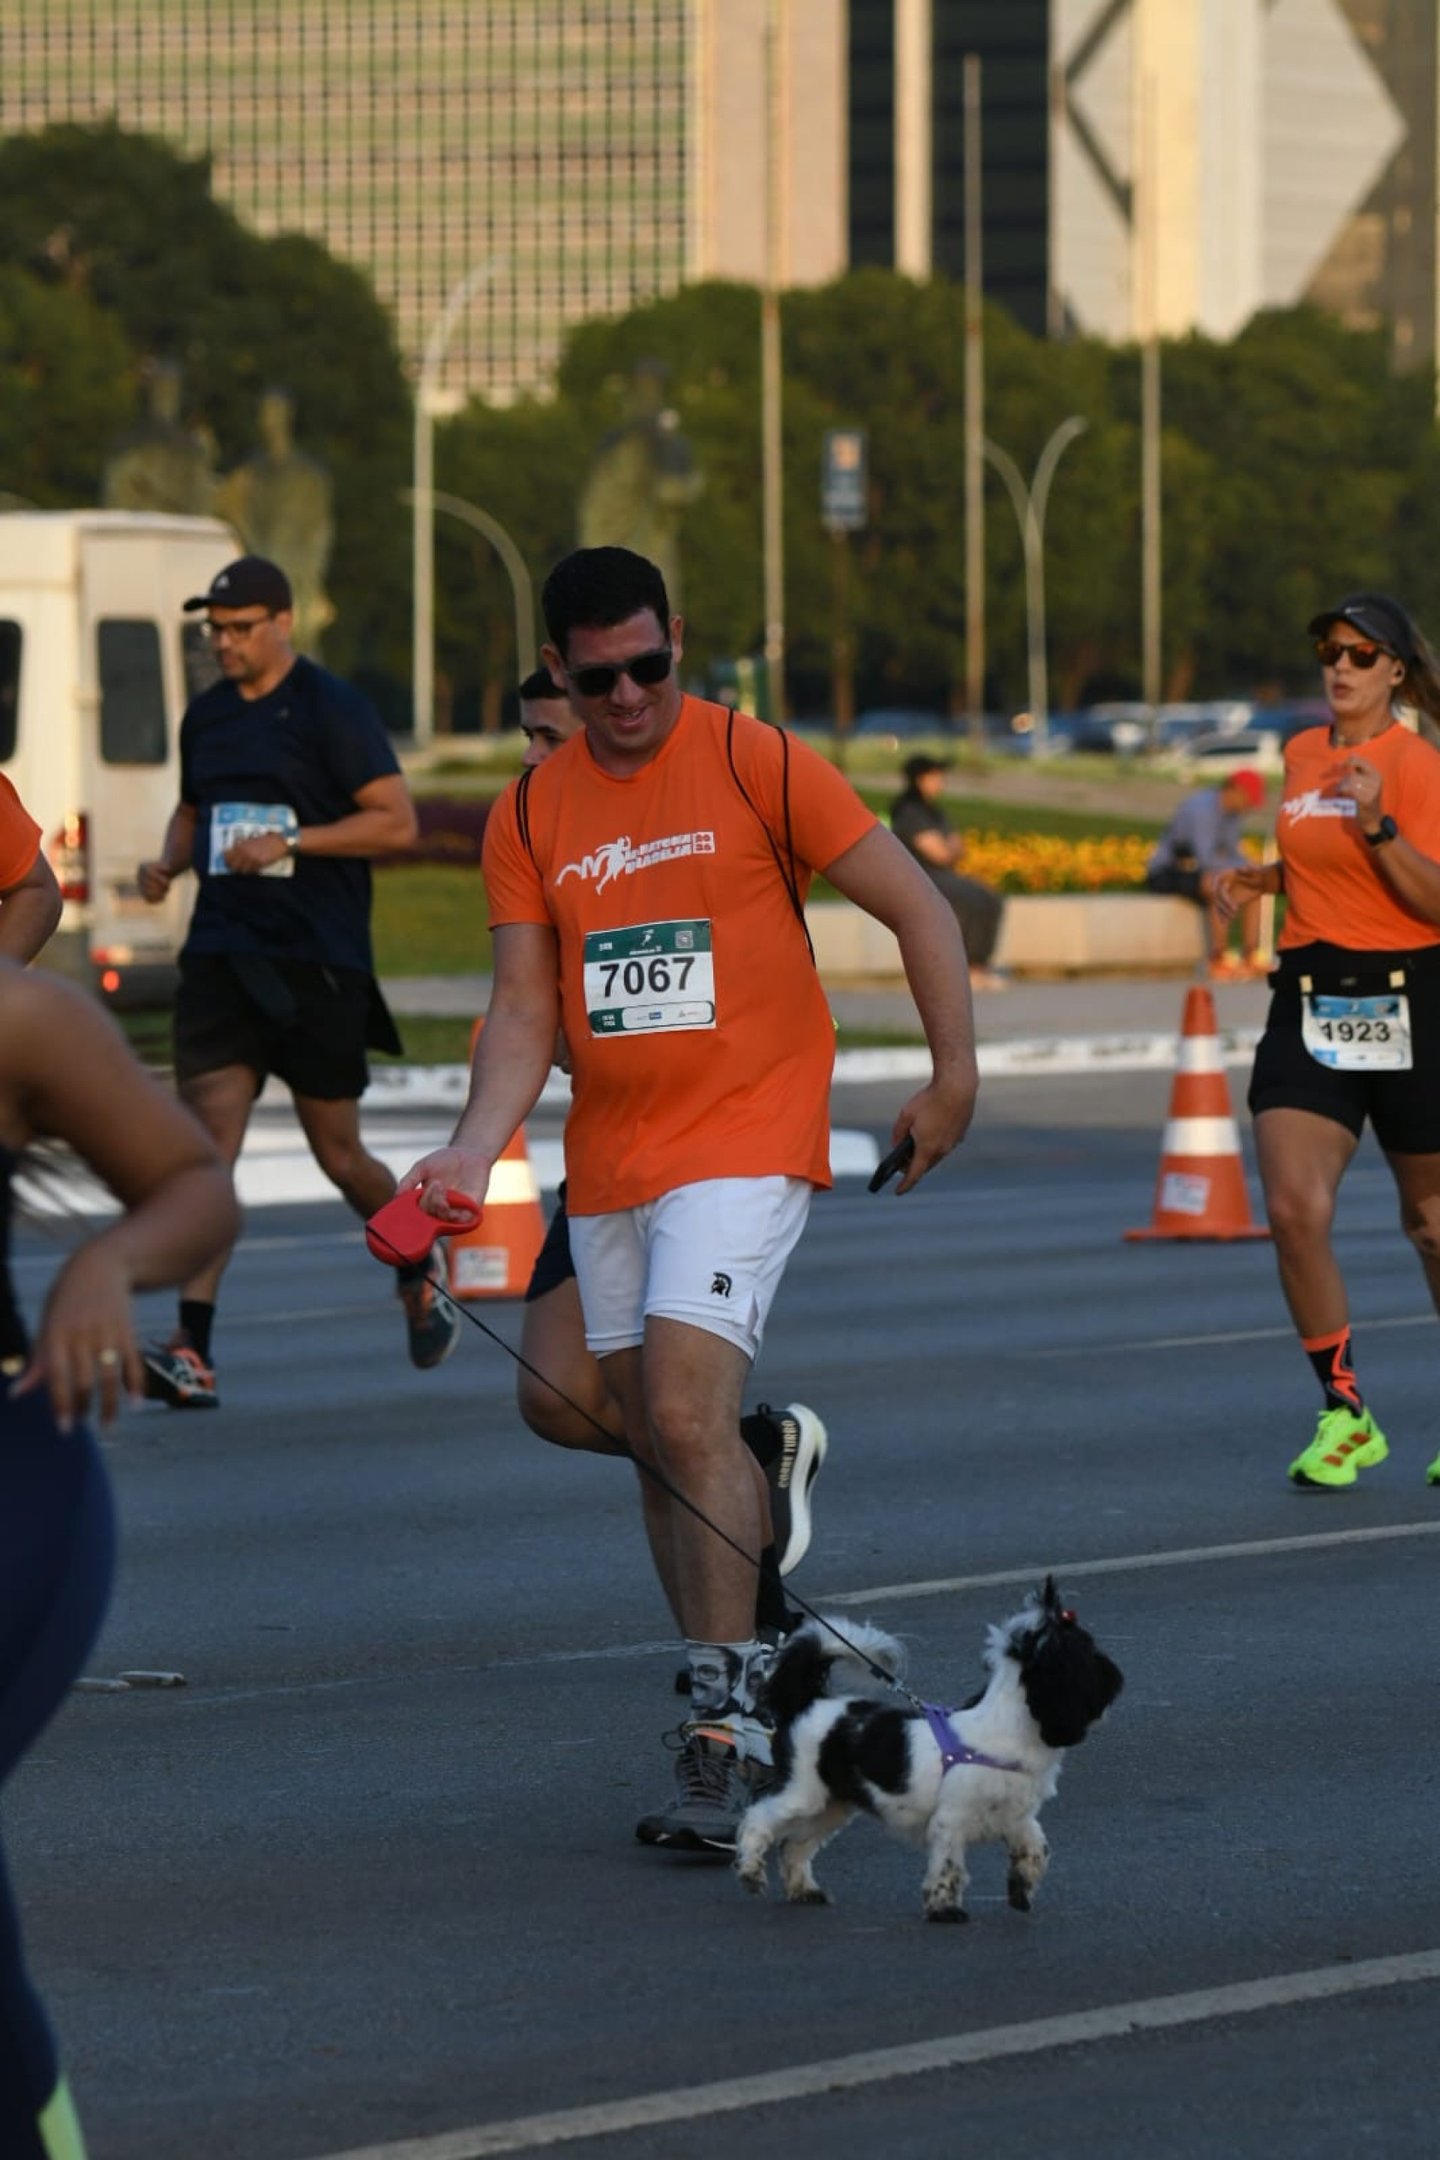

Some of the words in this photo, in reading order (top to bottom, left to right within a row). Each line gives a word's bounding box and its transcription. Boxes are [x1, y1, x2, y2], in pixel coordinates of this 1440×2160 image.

[599, 956, 695, 998] 7067
[1320, 1021, 1391, 1042] 1923
[781, 1419, 797, 1453] TURBO
